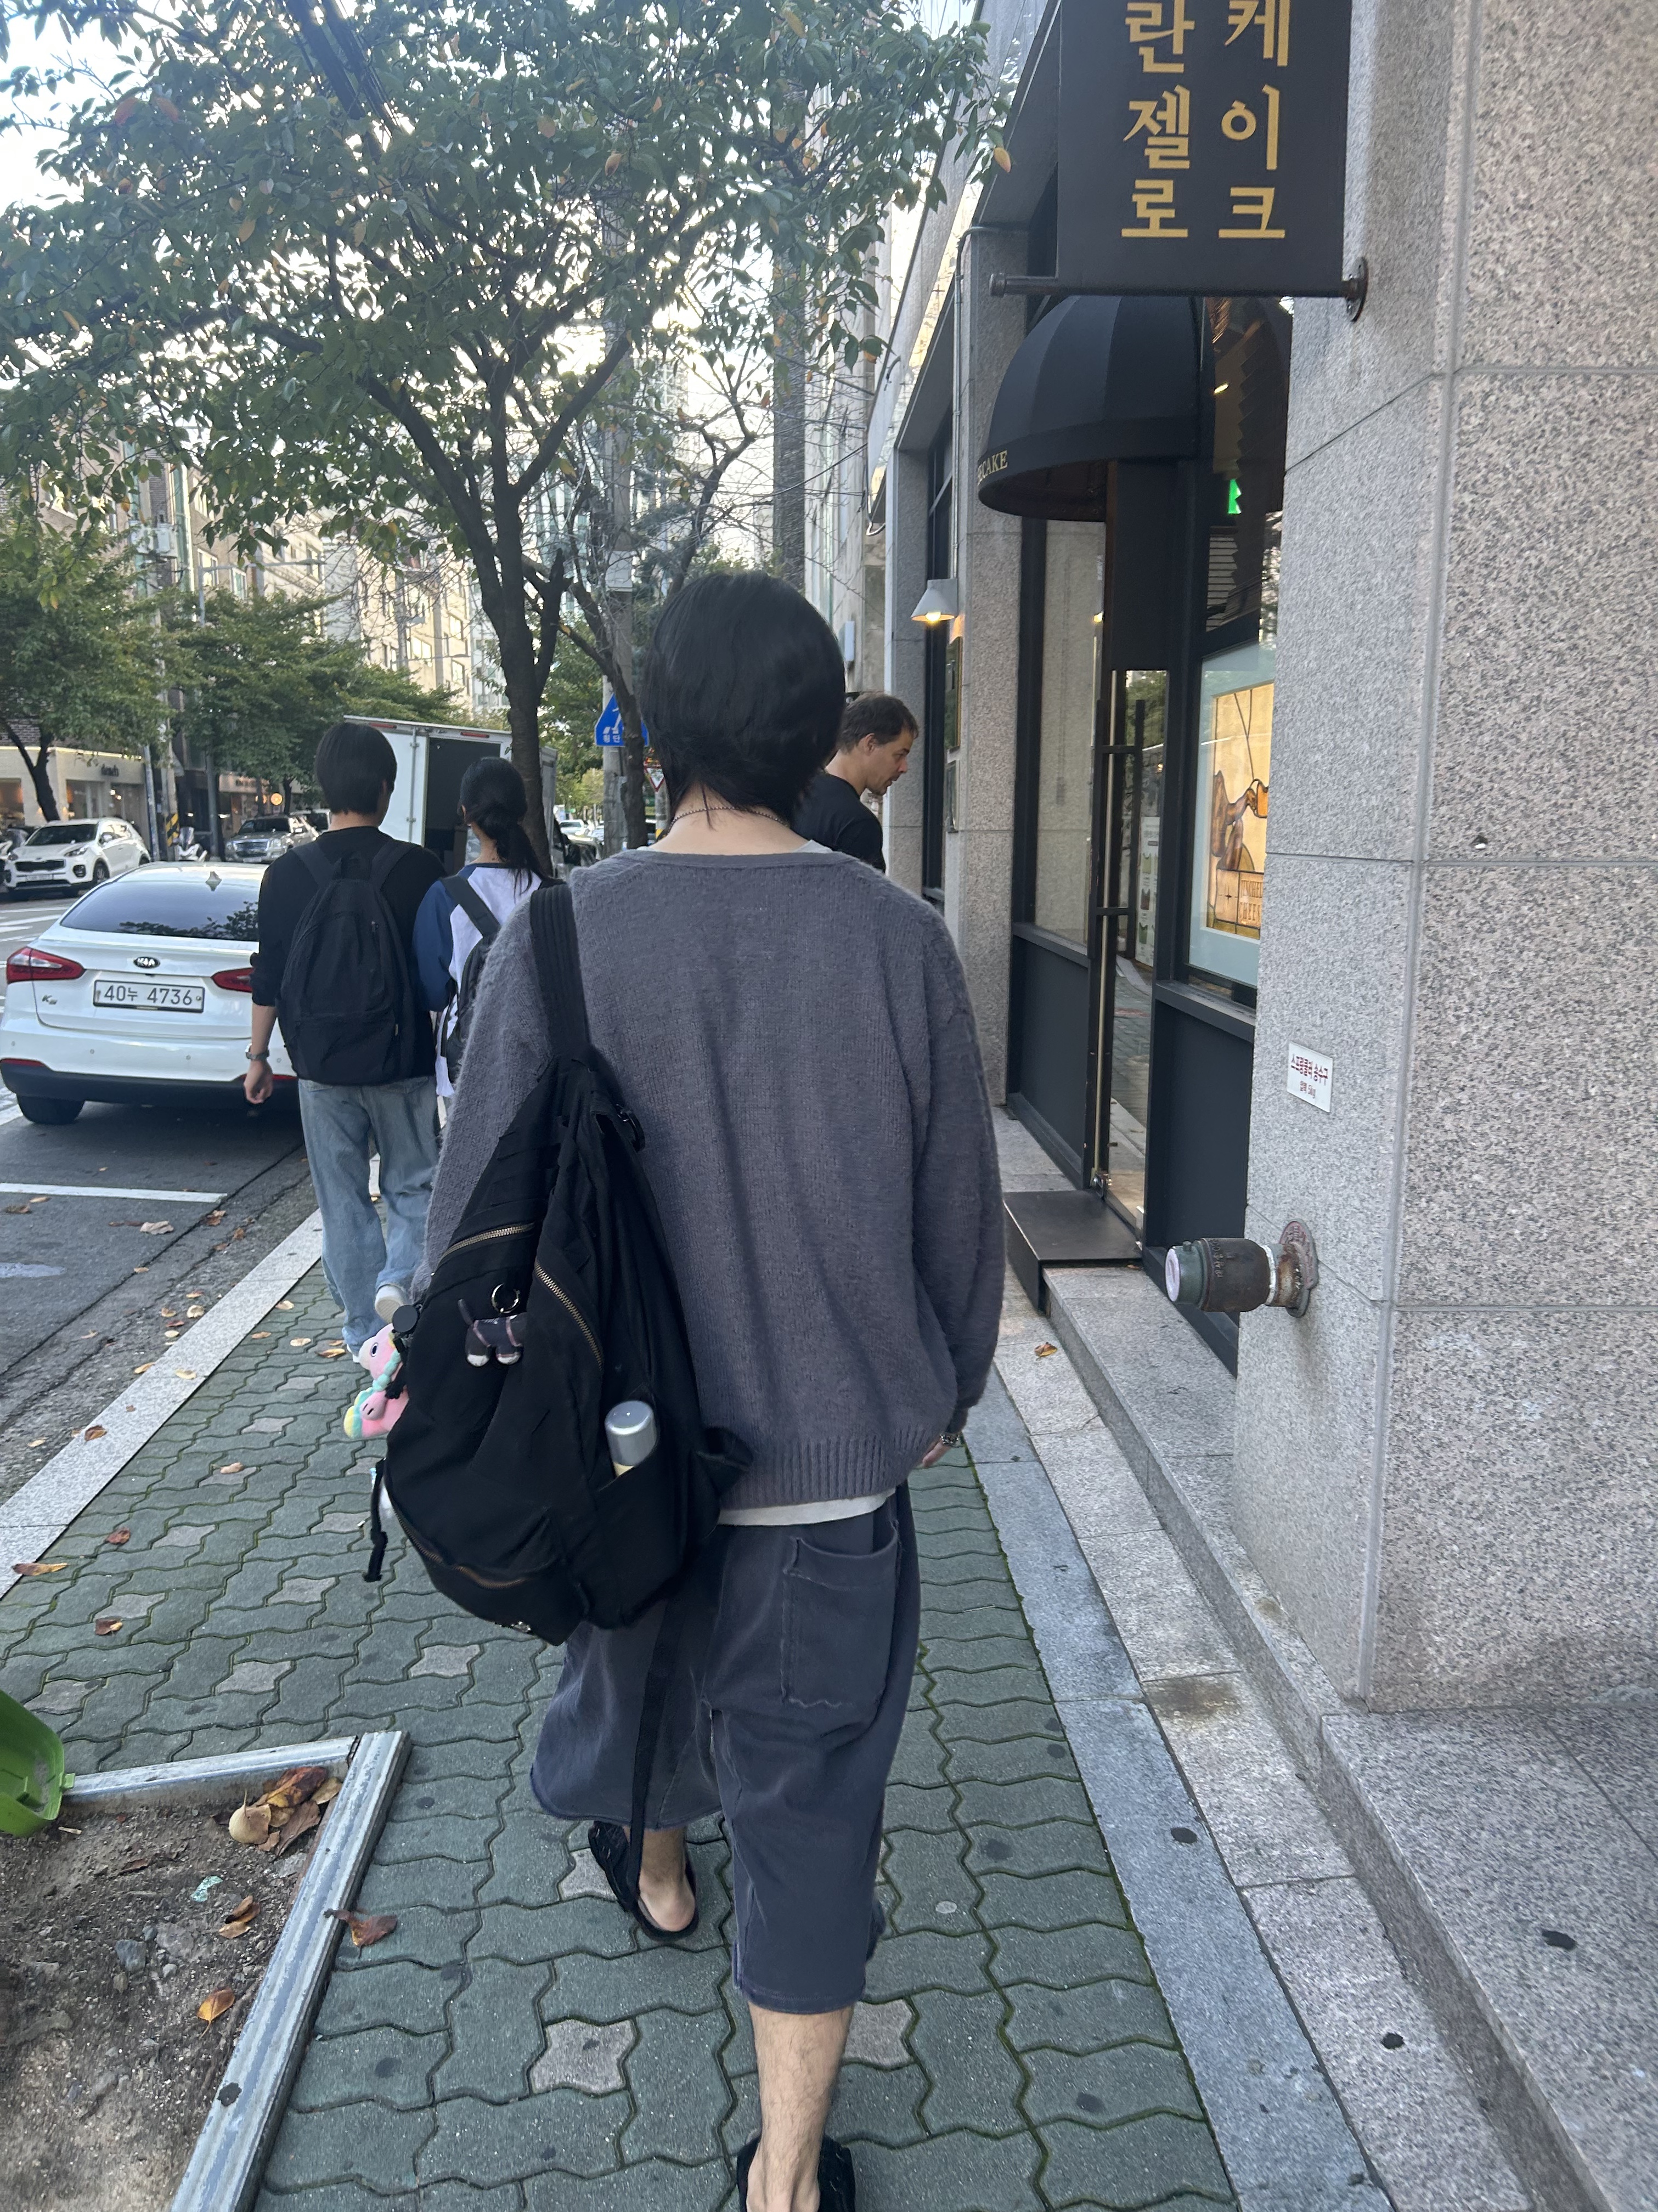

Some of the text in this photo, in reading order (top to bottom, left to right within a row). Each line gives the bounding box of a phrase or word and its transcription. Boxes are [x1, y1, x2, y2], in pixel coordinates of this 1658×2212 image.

[1121, 0, 1195, 238] 란젤로
[1218, 0, 1291, 239] 케이크
[104, 985, 192, 1005] 40누 4736
[137, 957, 155, 966] KIA
